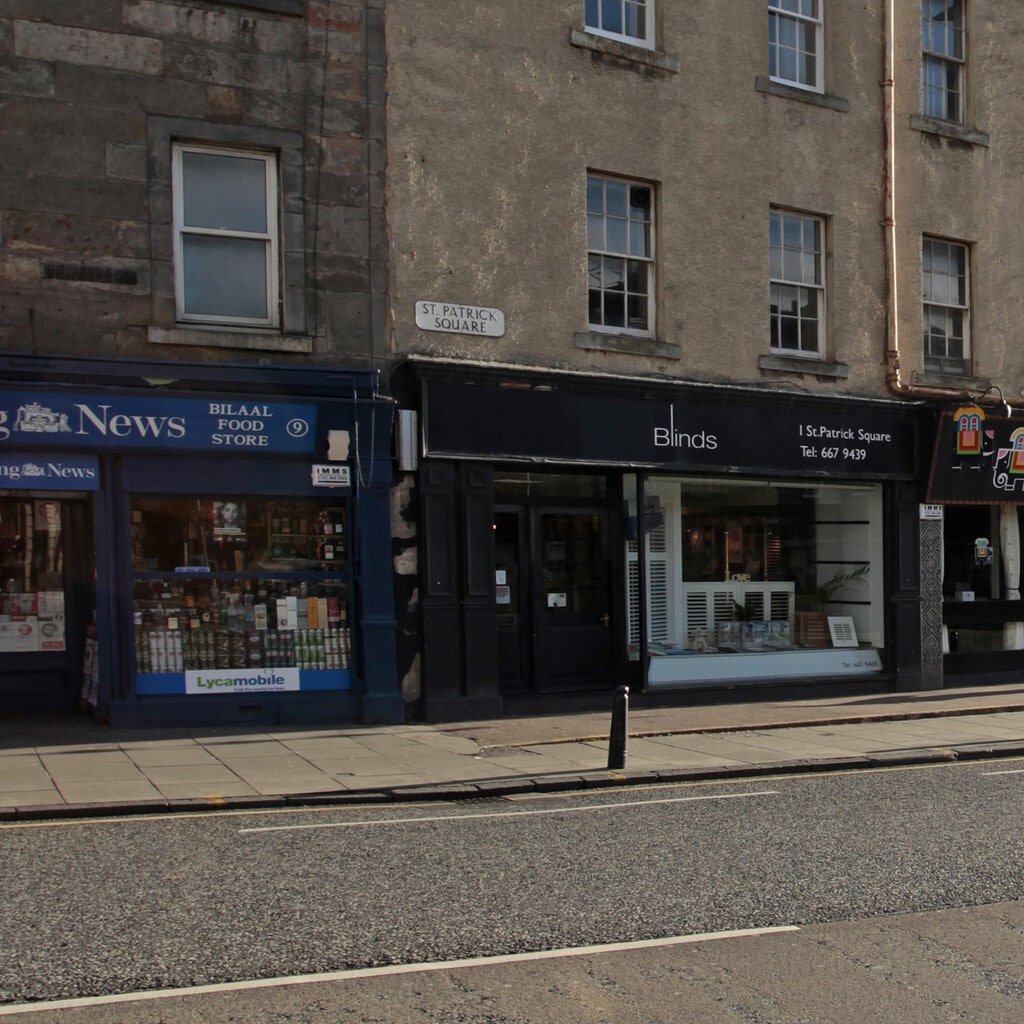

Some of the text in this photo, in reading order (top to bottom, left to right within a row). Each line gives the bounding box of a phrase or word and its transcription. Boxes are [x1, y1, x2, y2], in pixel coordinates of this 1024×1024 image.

[443, 305, 498, 322] PATRICK
[434, 317, 487, 333] SQUARE
[208, 403, 273, 418] BILAAL
[74, 403, 186, 439] News
[217, 419, 264, 433] FOOD
[653, 404, 718, 450] Blinds
[211, 434, 269, 447] STORE
[857, 429, 892, 444] Square
[800, 445, 867, 460] Tel: 667 9439
[47, 463, 96, 479] News
[196, 675, 285, 689] Lycamobile
